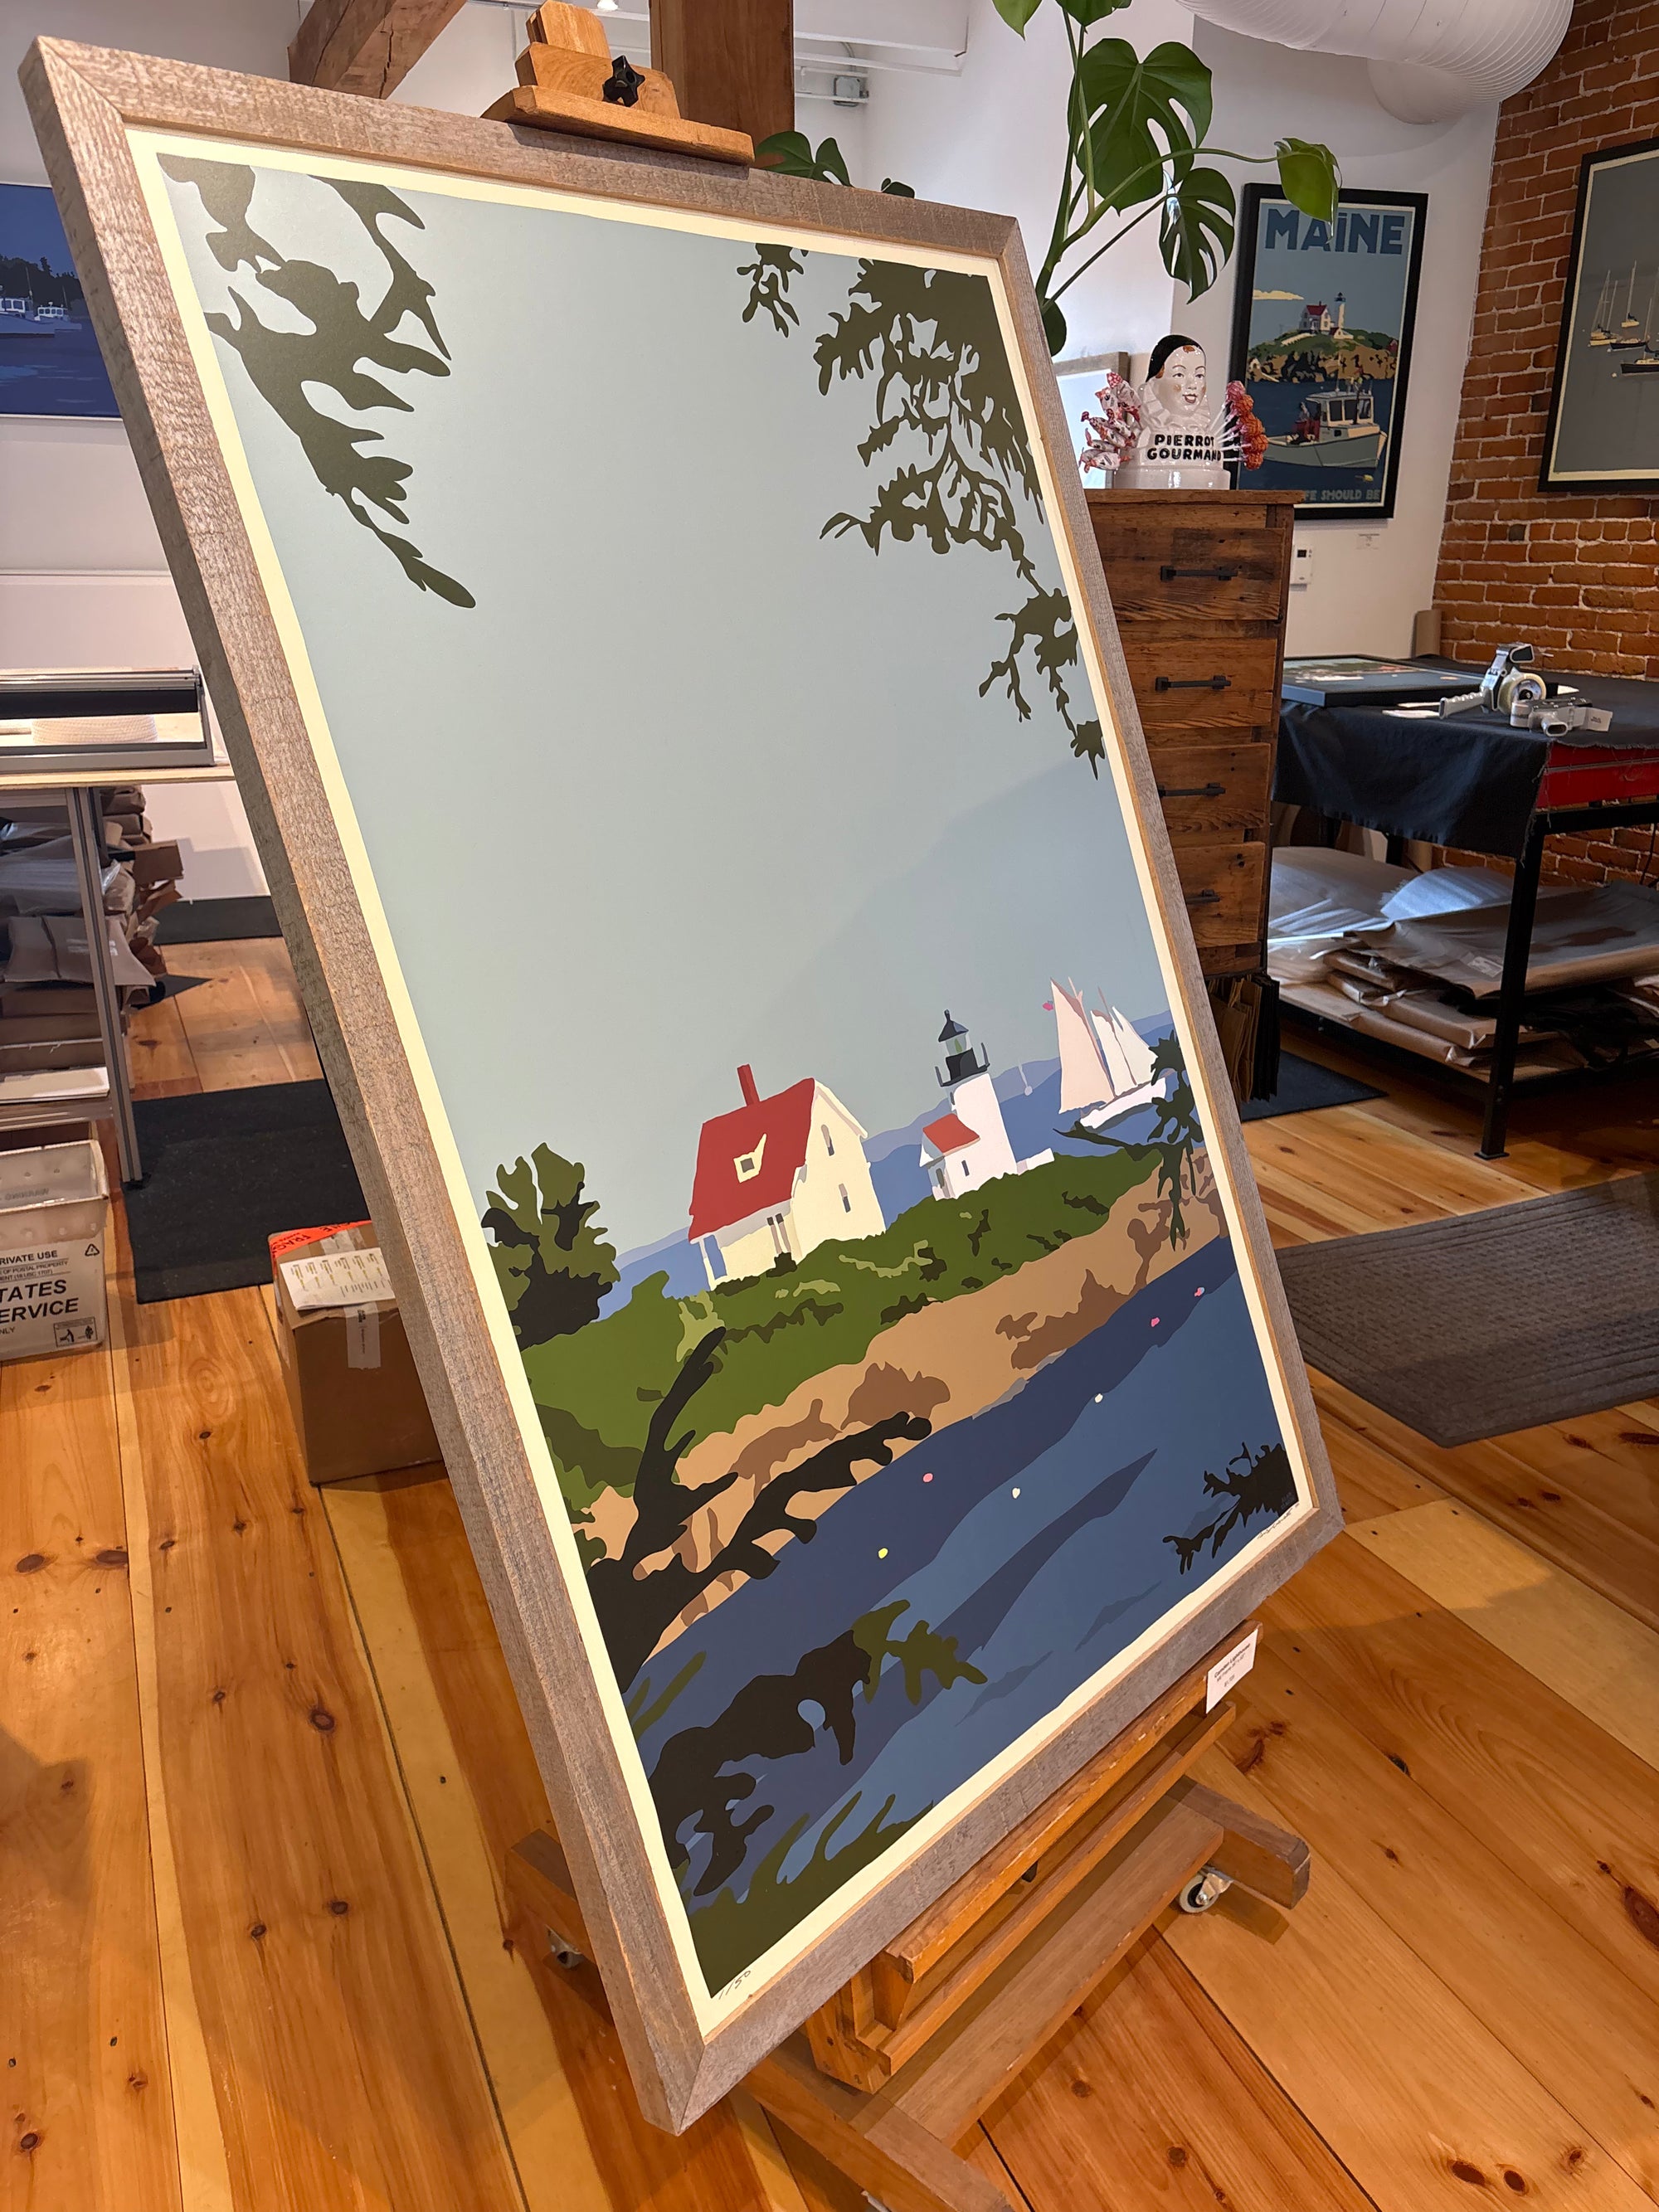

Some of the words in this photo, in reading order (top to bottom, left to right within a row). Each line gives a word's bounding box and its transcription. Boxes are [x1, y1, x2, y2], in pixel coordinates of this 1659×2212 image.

[1154, 434, 1214, 447] PIERROT
[1146, 448, 1222, 461] GOURMAND
[1321, 489, 1362, 501] SHOULD
[1365, 489, 1381, 501] BE
[0, 1252, 35, 1266] RIVATE
[37, 1250, 58, 1260] USE
[12, 1266, 35, 1274] POSTAL
[36, 1261, 68, 1270] PROPERTY
[0, 1279, 67, 1304] TATES
[0, 1297, 79, 1325] ERVICE
[0, 1326, 16, 1335] NLY
